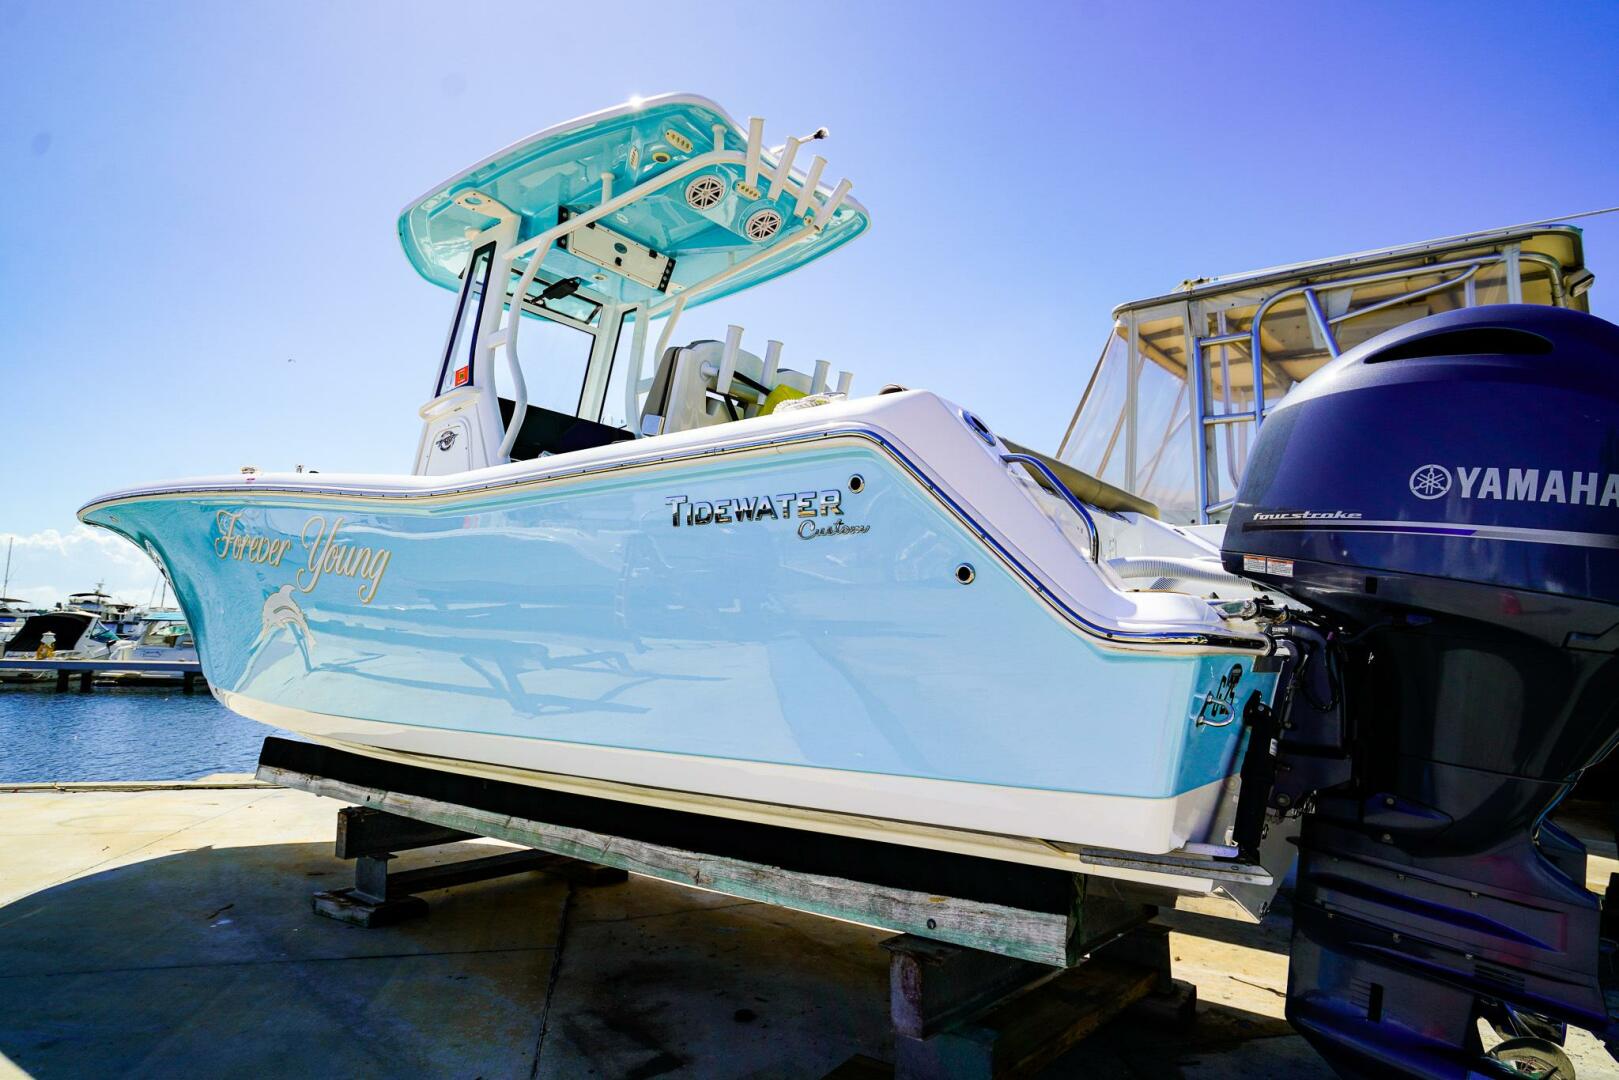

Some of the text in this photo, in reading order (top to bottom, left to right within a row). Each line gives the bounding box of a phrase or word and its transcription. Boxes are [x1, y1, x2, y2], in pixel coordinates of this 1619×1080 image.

[1456, 466, 1619, 508] YAMAHA
[214, 509, 392, 604] Forever Young
